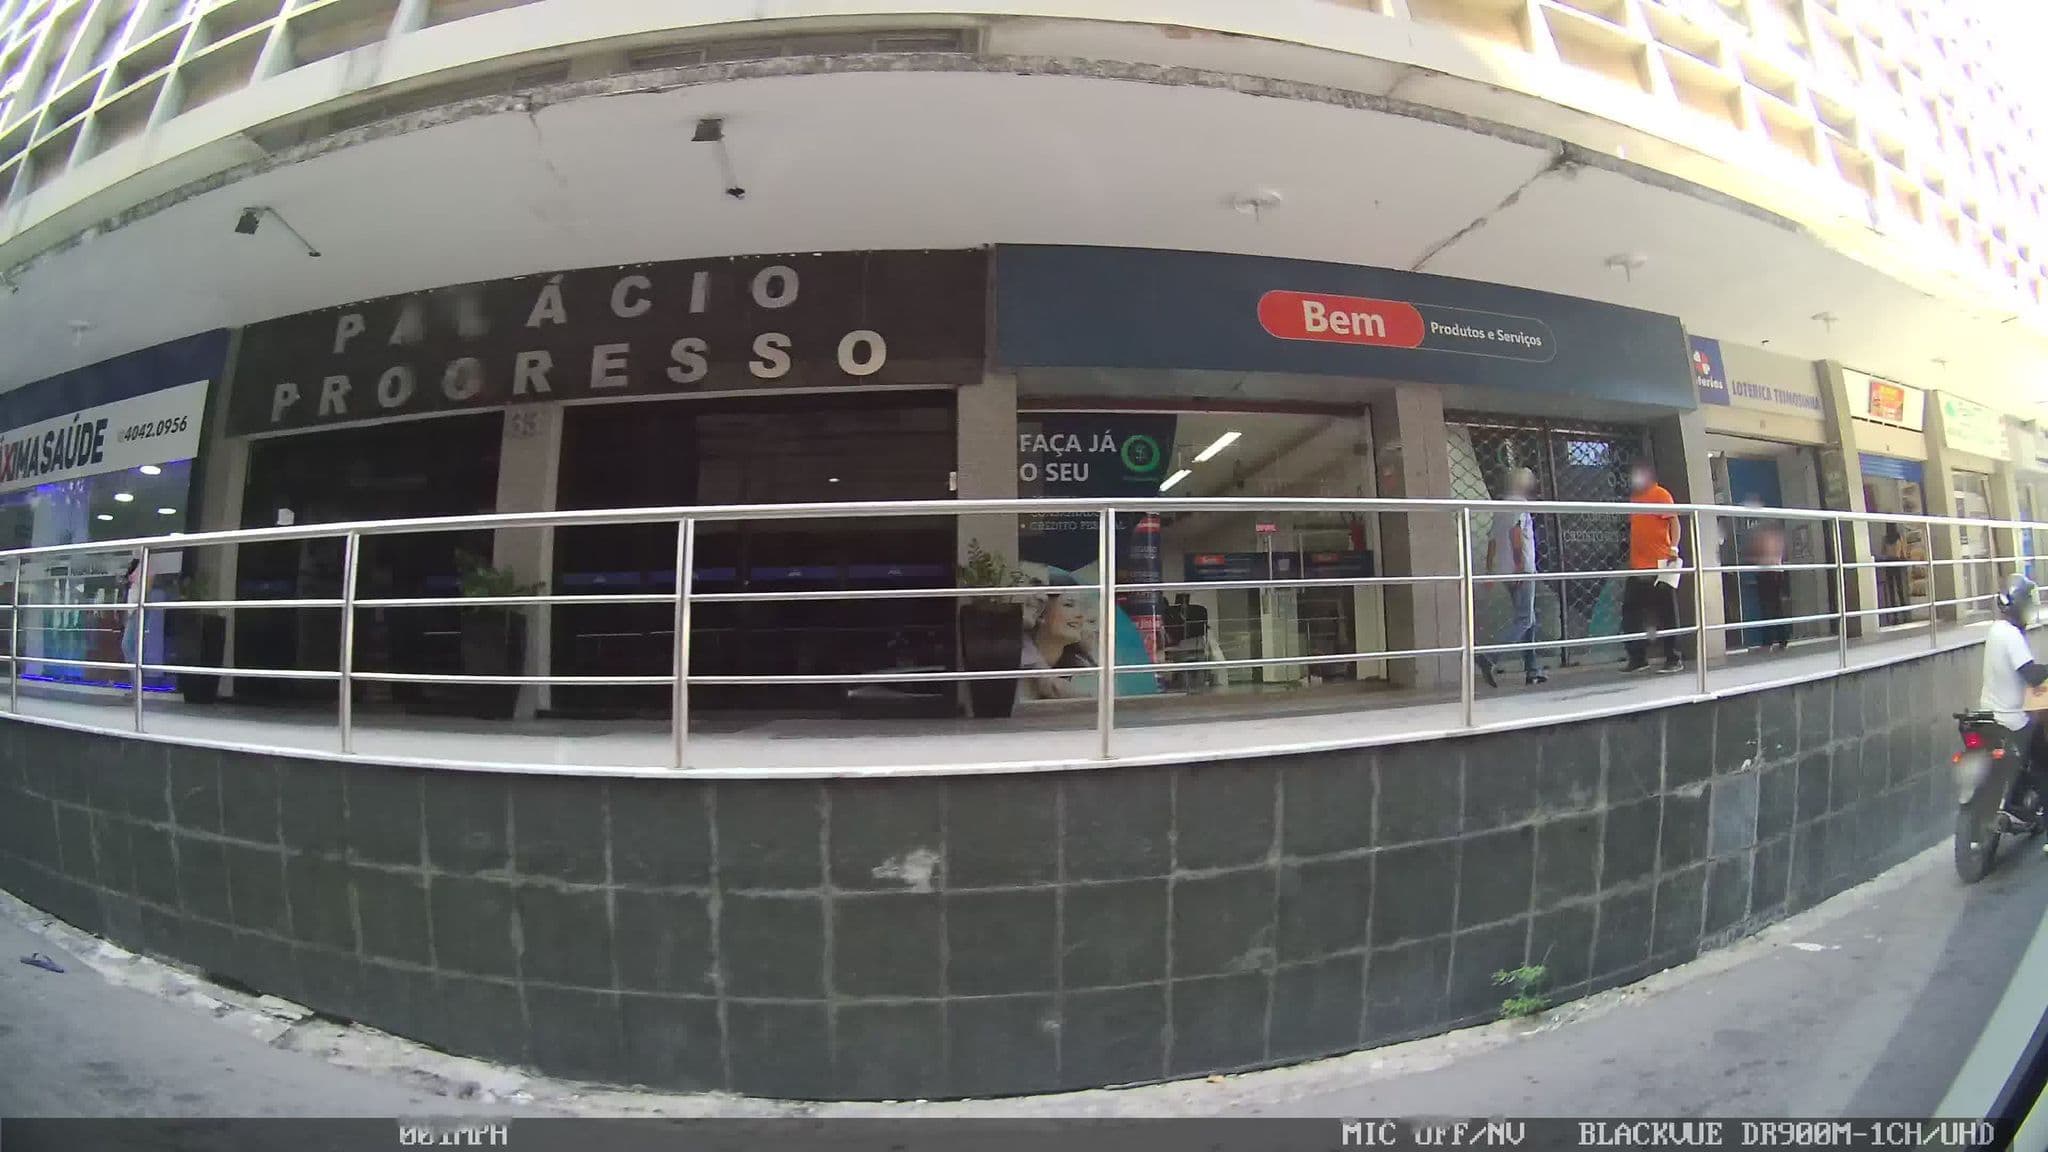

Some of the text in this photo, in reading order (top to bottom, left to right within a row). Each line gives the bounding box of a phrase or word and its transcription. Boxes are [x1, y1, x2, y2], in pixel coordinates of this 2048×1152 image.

[333, 265, 799, 354] PALÁCIO
[1302, 300, 1386, 338] Bem
[1430, 321, 1542, 348] Produtos e Serviços
[271, 330, 887, 422] PROGRESSO
[124, 415, 188, 443] 4042.0956
[1020, 429, 1117, 457] FAÇA JÁ
[1020, 463, 1089, 481] O SEU
